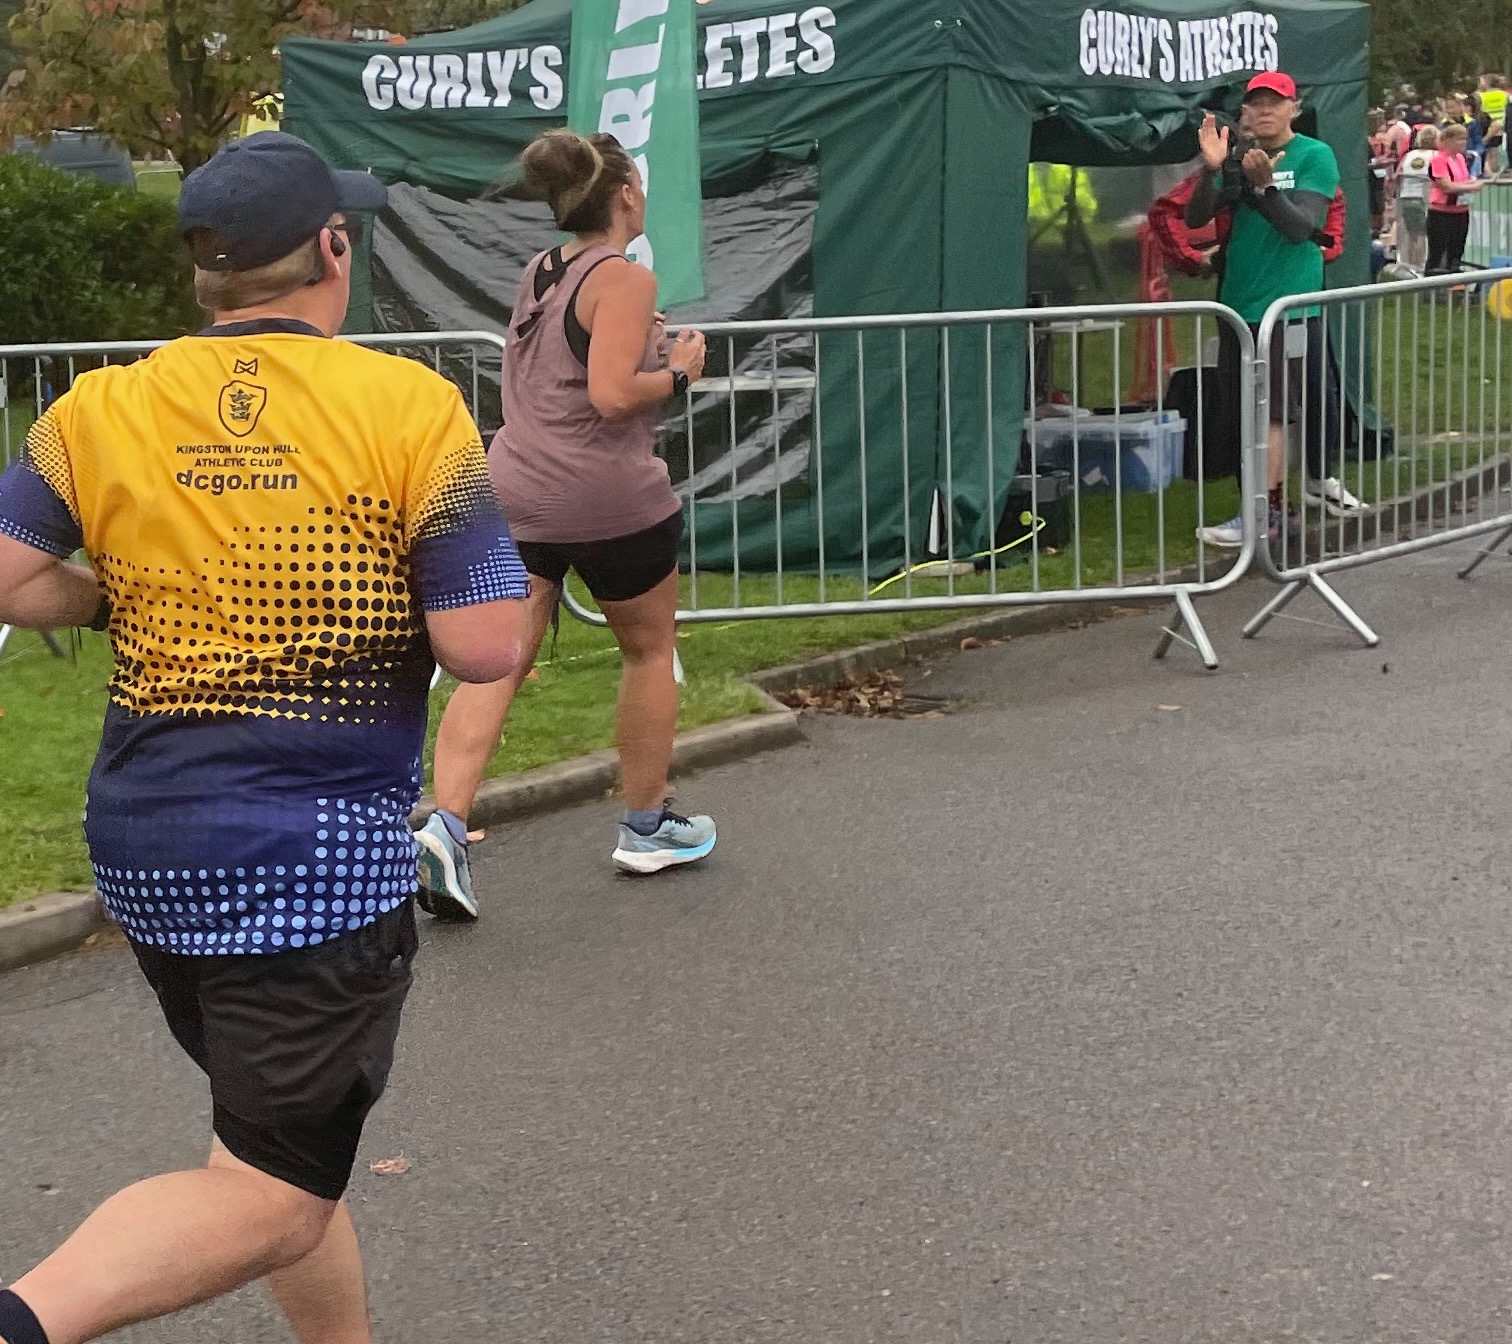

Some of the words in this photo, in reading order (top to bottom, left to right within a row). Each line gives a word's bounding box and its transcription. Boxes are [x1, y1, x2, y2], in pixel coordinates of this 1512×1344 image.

[362, 45, 563, 110] CURLY'S
[697, 6, 836, 89] ETES
[1079, 9, 1175, 82] CURLY'S
[1178, 11, 1278, 82] ATHLETES
[176, 445, 231, 454] KINGSTON
[235, 445, 269, 454] UPON
[195, 457, 246, 467] ATHLETIC
[250, 457, 282, 467] CLUB
[176, 469, 298, 496] dcgo.run
